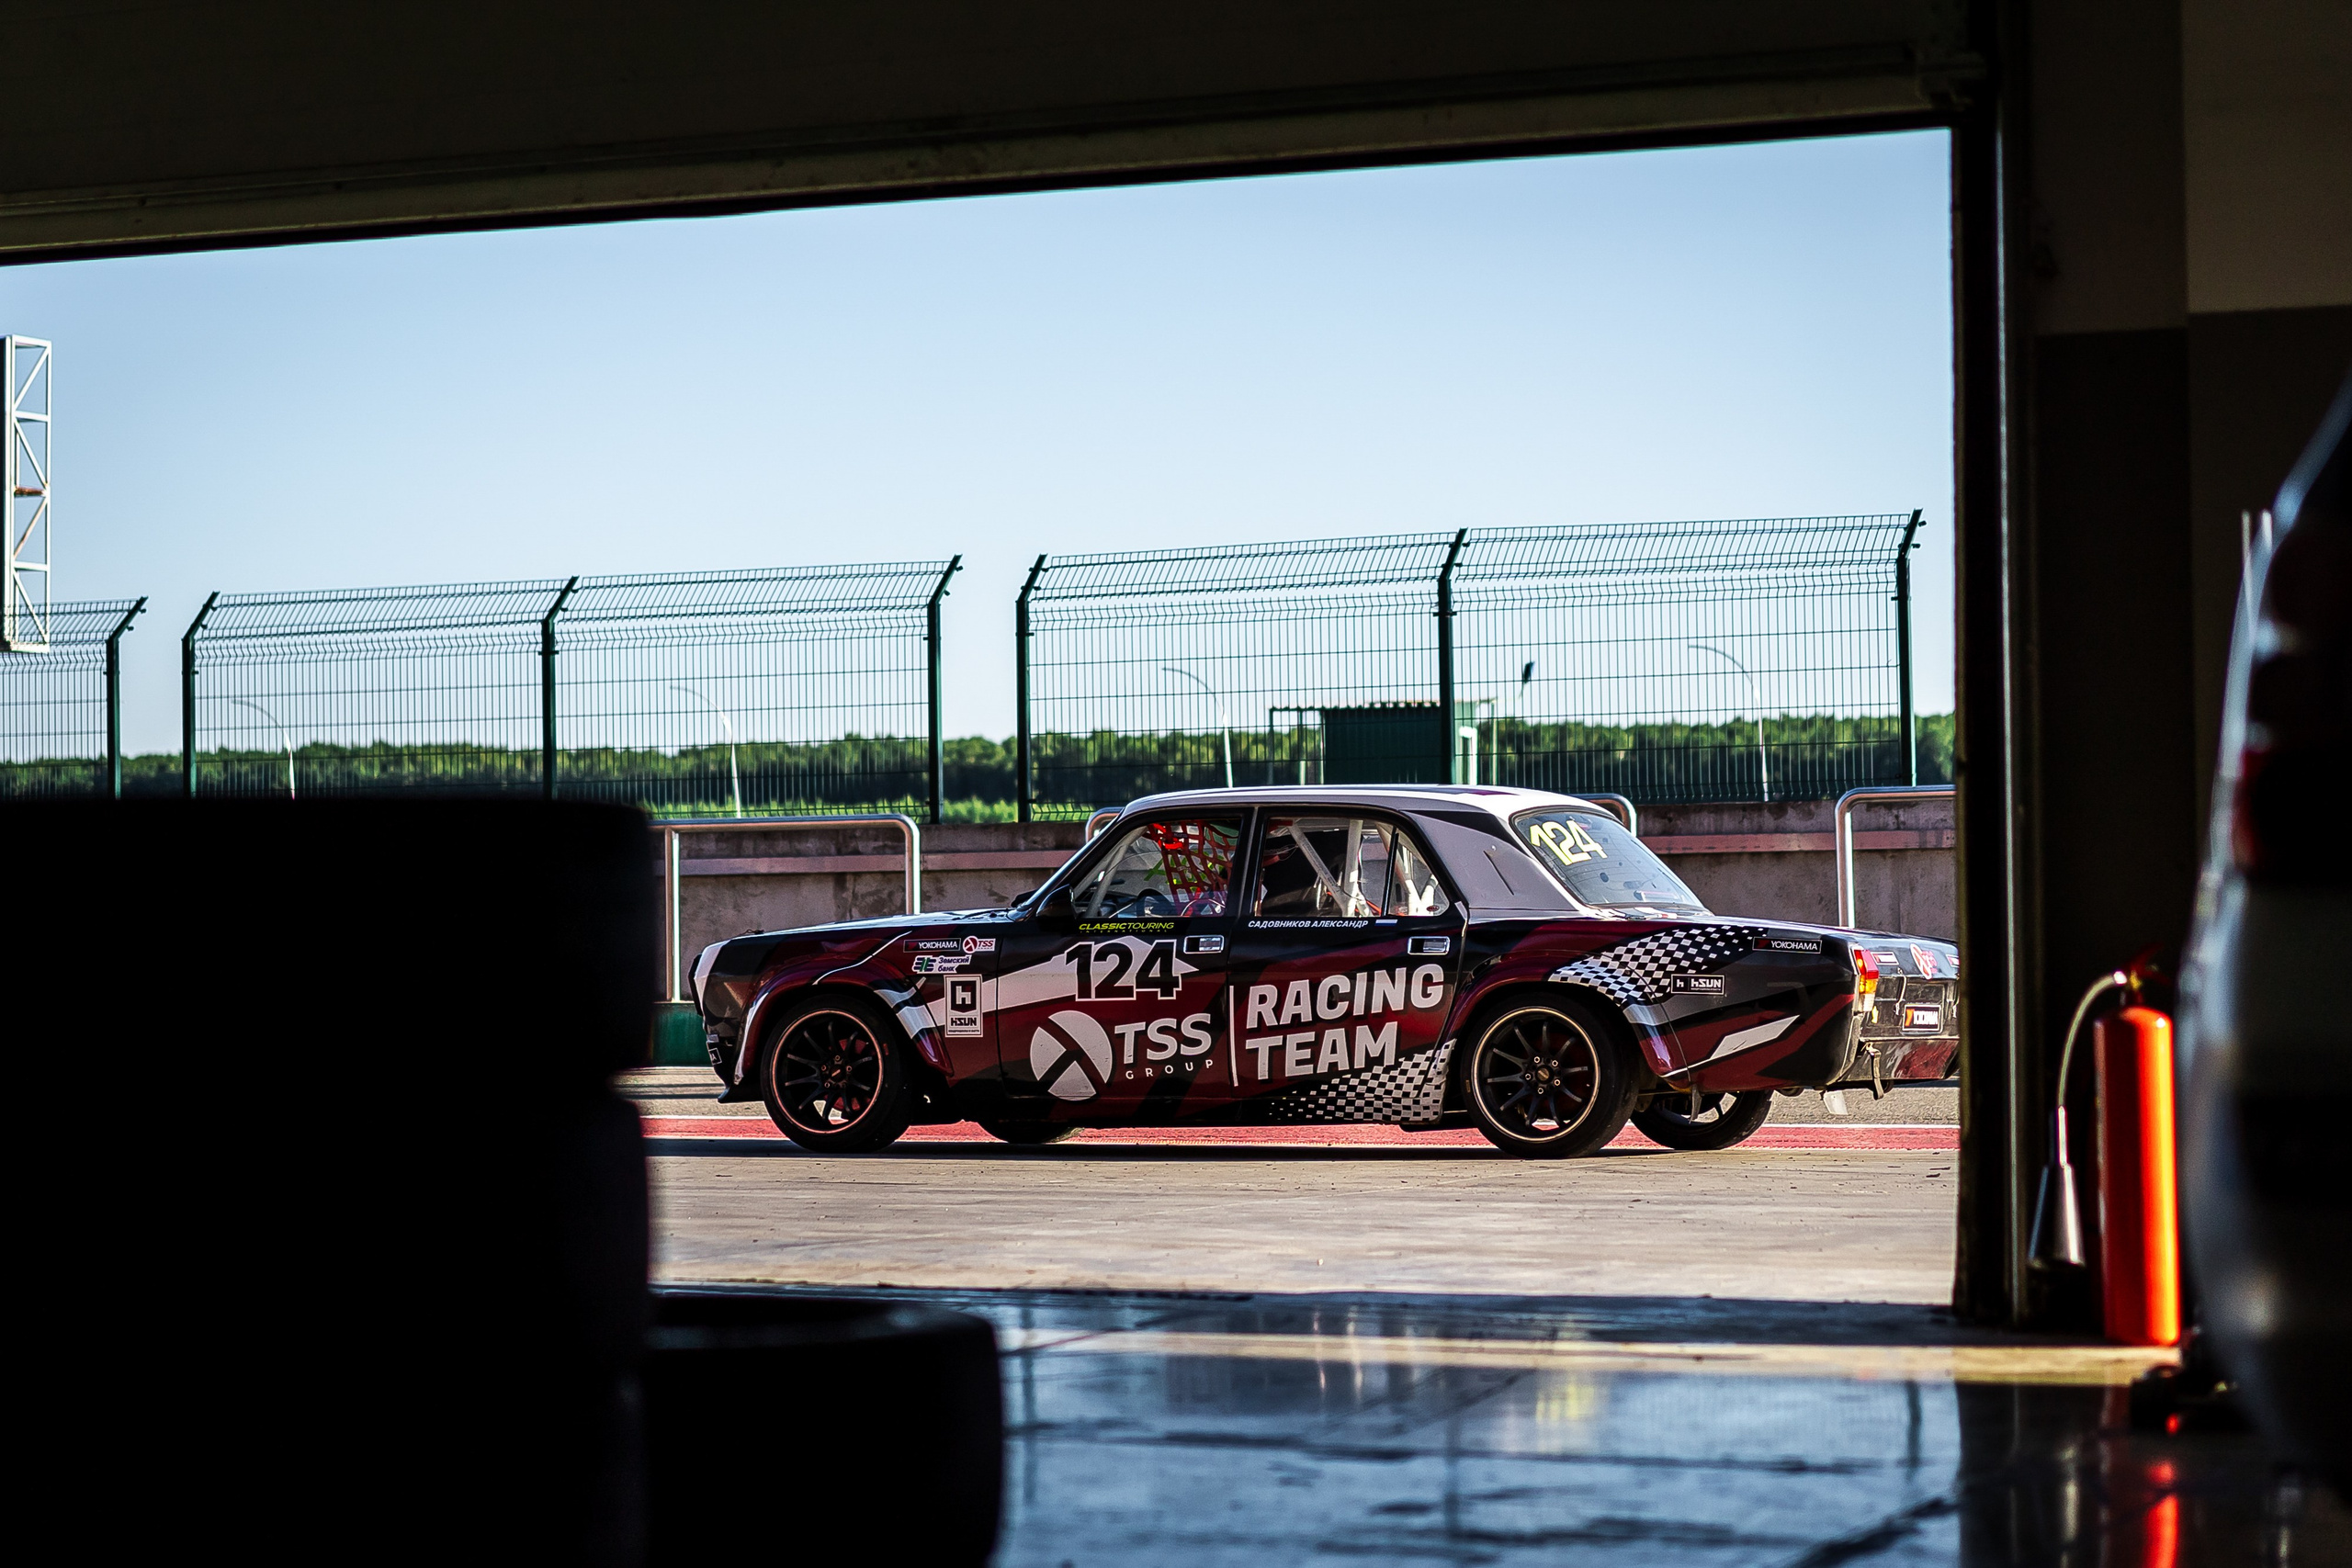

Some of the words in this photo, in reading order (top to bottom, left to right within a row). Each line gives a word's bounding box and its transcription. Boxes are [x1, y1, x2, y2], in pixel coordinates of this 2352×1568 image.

[1530, 819, 1608, 865] 124
[919, 941, 957, 949] YOKOHAMA
[1249, 920, 1310, 929] САДОВНИКОВ
[1311, 920, 1368, 929] АЛЕКСАНДР
[1770, 940, 1817, 950] YOKOHAMA
[1065, 939, 1182, 1001] 124
[1247, 964, 1444, 1029] RACING
[1114, 1013, 1211, 1064] TSS
[1245, 1021, 1398, 1079] TEAM
[1125, 1059, 1214, 1079] GROUP
